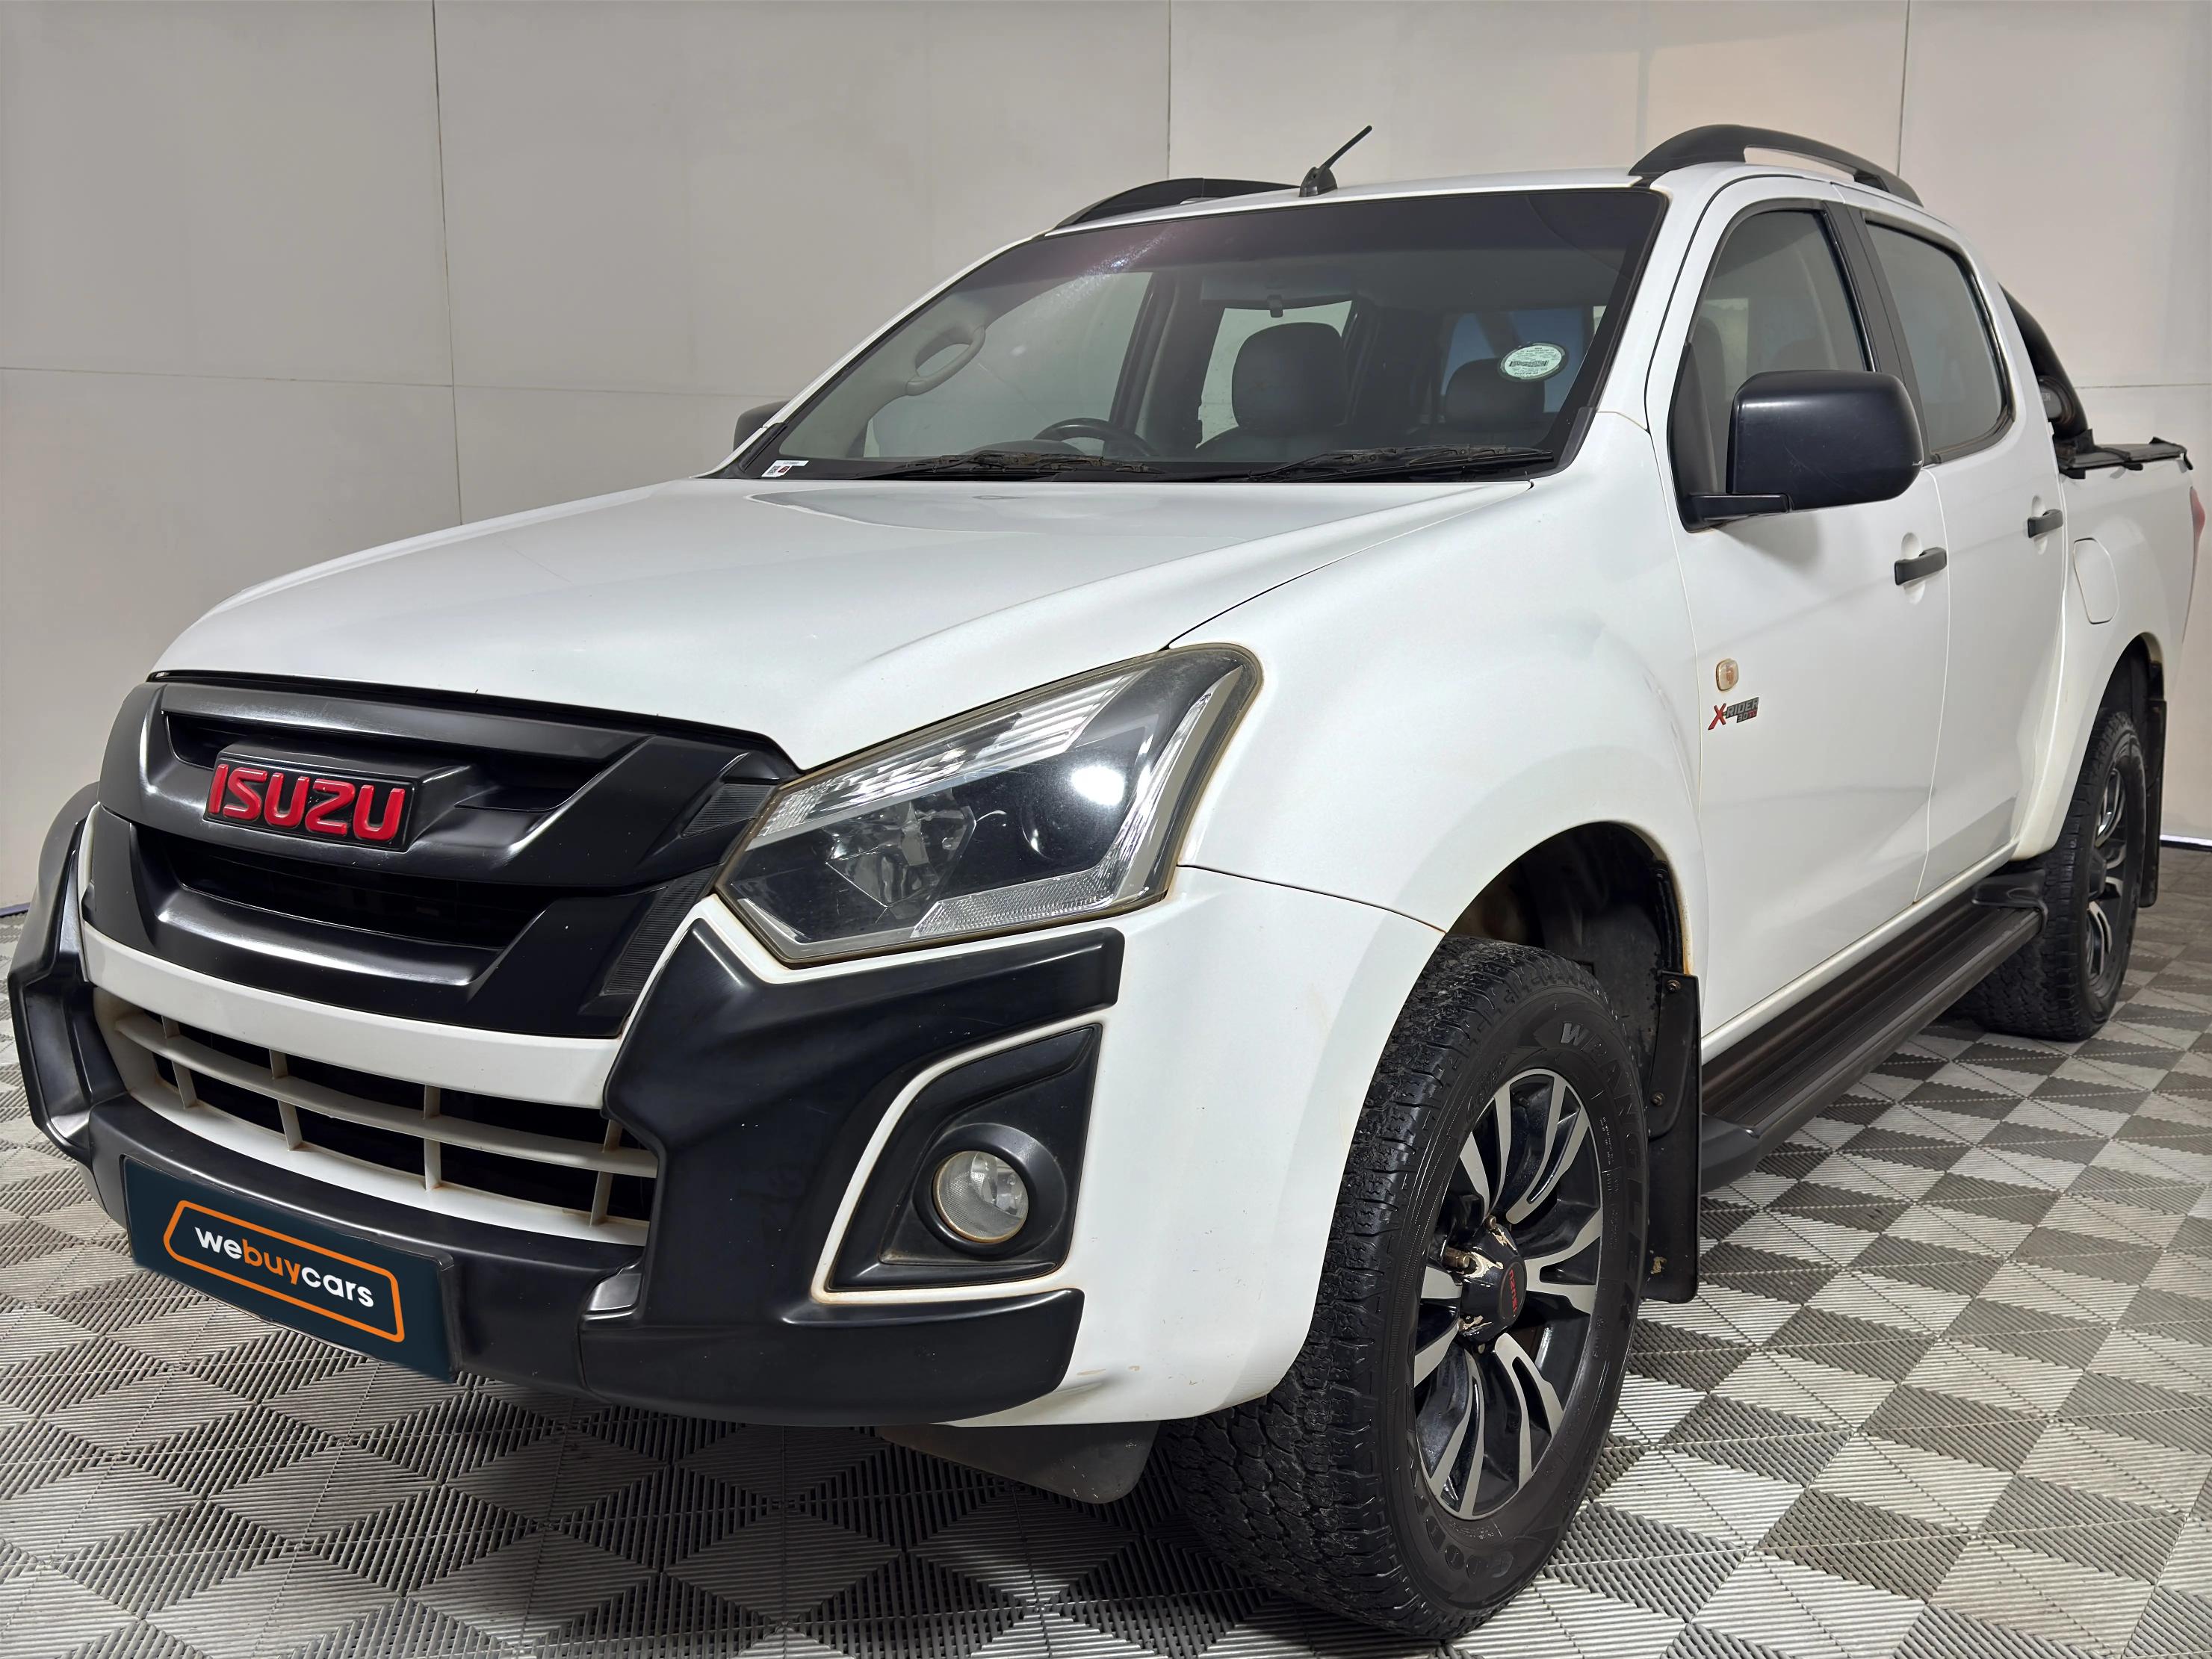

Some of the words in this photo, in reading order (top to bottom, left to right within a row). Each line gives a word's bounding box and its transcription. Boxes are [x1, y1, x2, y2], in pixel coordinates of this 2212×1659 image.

[1708, 696, 1759, 730] X-RIDER
[208, 763, 406, 841] ISUZU
[1560, 1020, 1642, 1330] WRANGLER
[194, 1226, 374, 1308] webuycars
